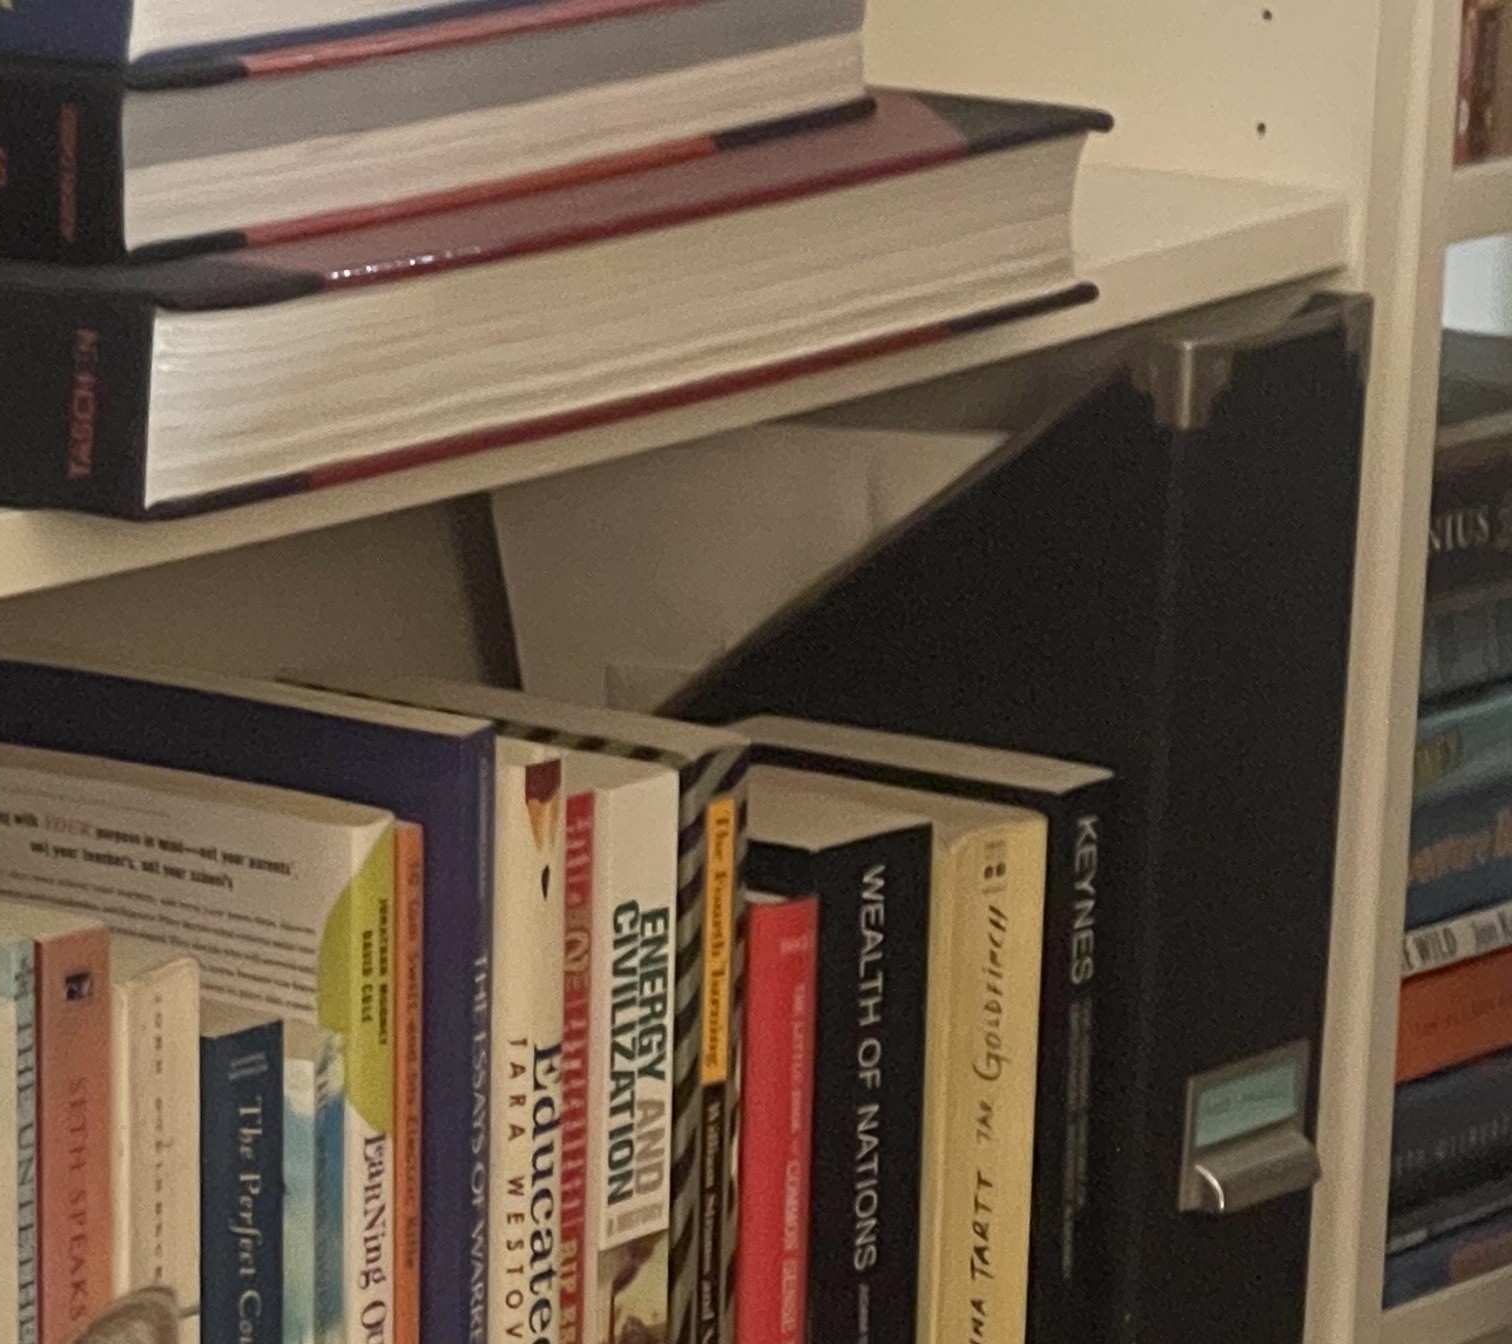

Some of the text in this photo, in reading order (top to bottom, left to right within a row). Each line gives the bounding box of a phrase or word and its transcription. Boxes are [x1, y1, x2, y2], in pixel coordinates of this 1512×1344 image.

[856, 863, 887, 1027] WEALTH
[1068, 813, 1101, 985] KEYNES
[608, 901, 640, 1205] CIVILIZATION
[634, 908, 670, 1194] ENERGY AND
[704, 968, 728, 1067] Turning
[856, 1036, 882, 1089] OF
[236, 1094, 265, 1158] The
[469, 1030, 490, 1153] ESSAYS
[507, 1036, 530, 1140] TARA
[66, 1077, 88, 1322] SETH SPEAKS
[231, 1173, 265, 1276] Perfect
[851, 1101, 881, 1270] NATIONS
[967, 1172, 998, 1280] TARTT
